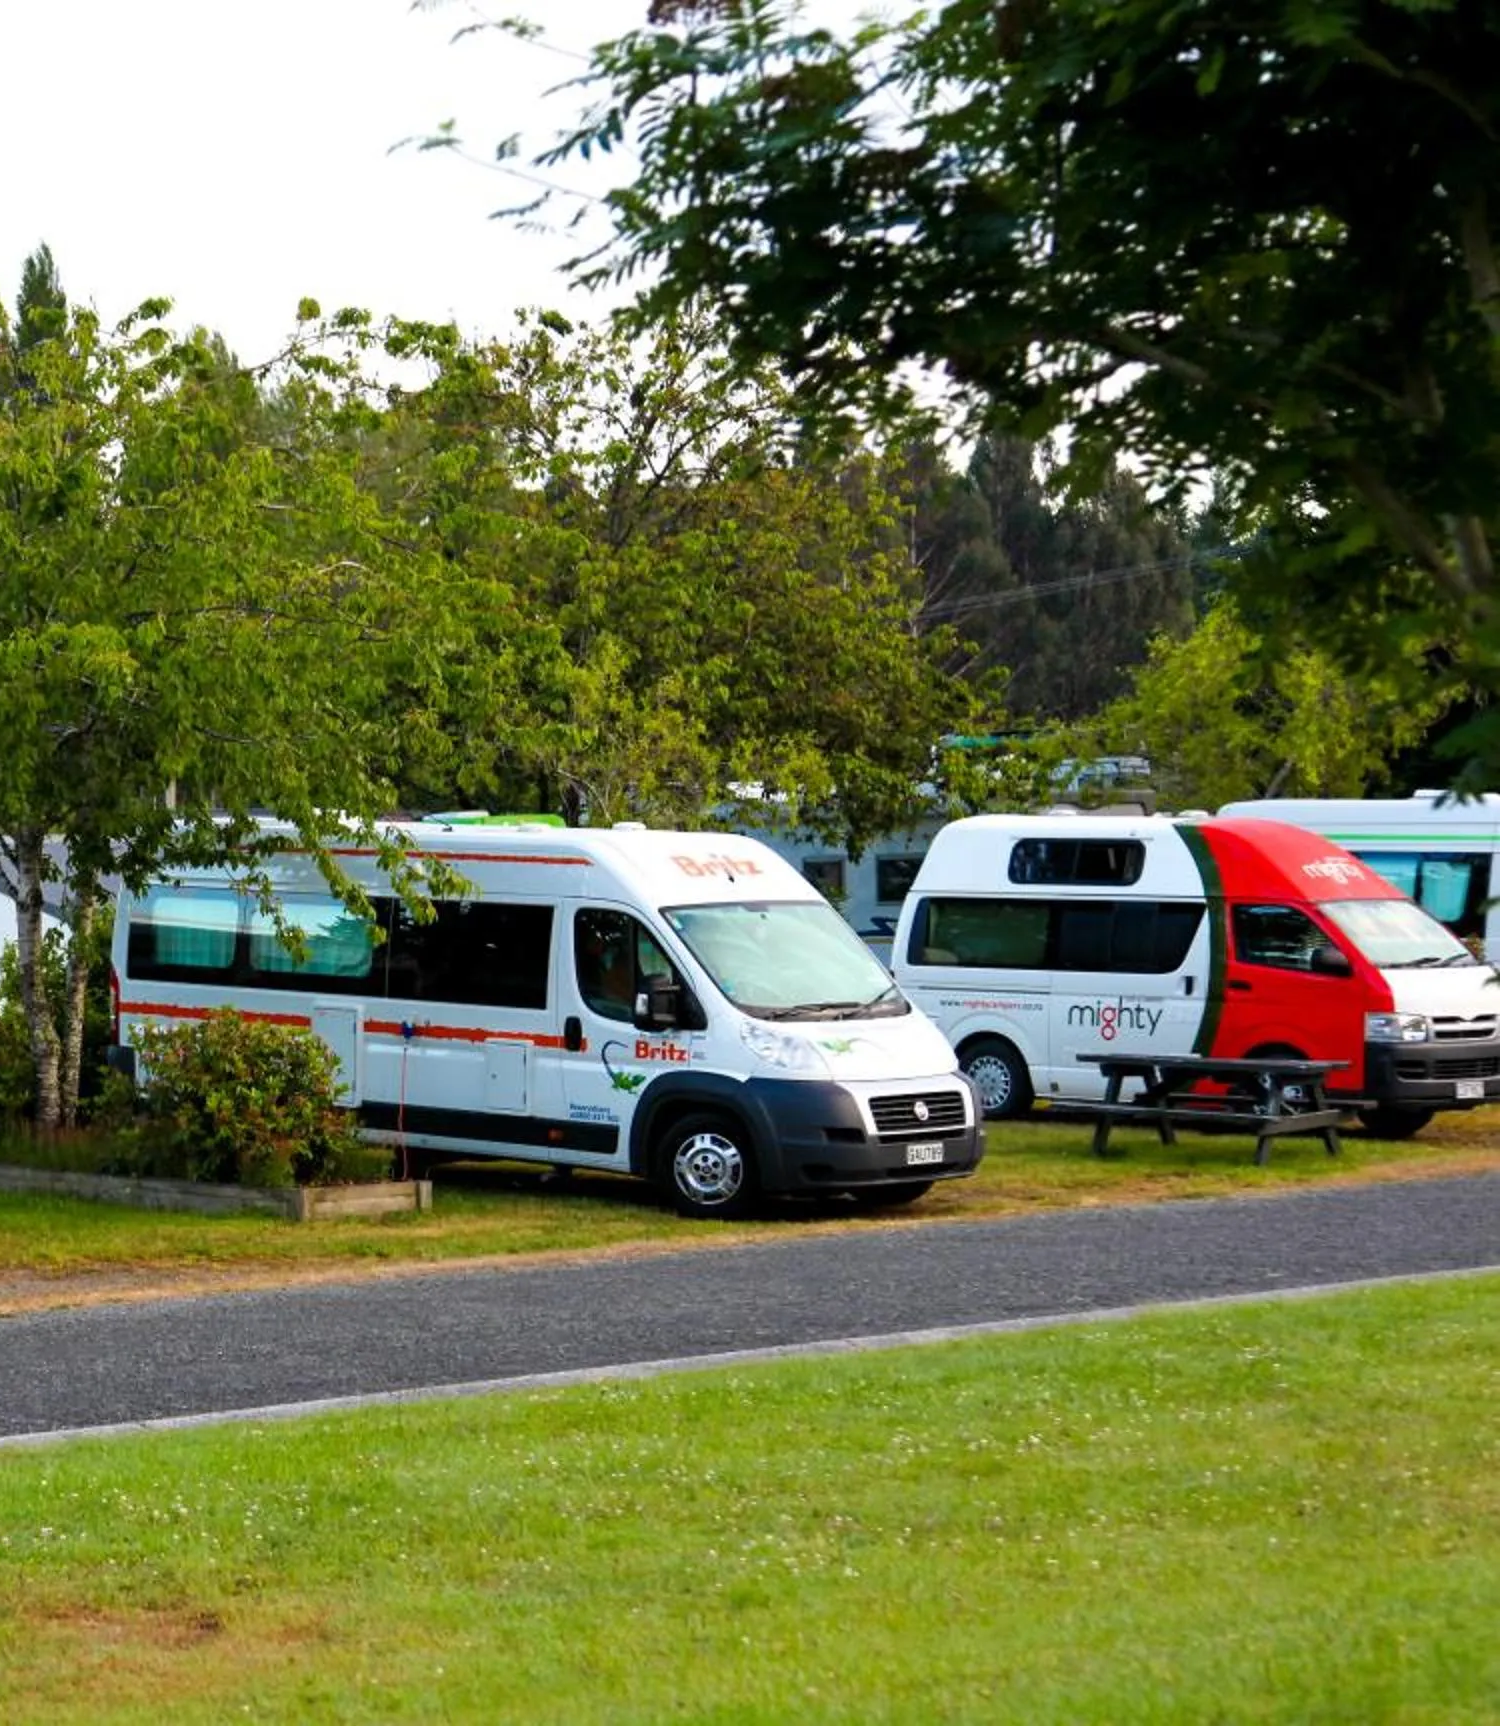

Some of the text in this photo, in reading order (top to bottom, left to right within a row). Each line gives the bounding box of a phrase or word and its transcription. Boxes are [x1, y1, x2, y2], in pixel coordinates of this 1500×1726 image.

[670, 852, 763, 877] Britz
[1067, 995, 1163, 1040] mighty
[635, 1039, 687, 1061] Britz
